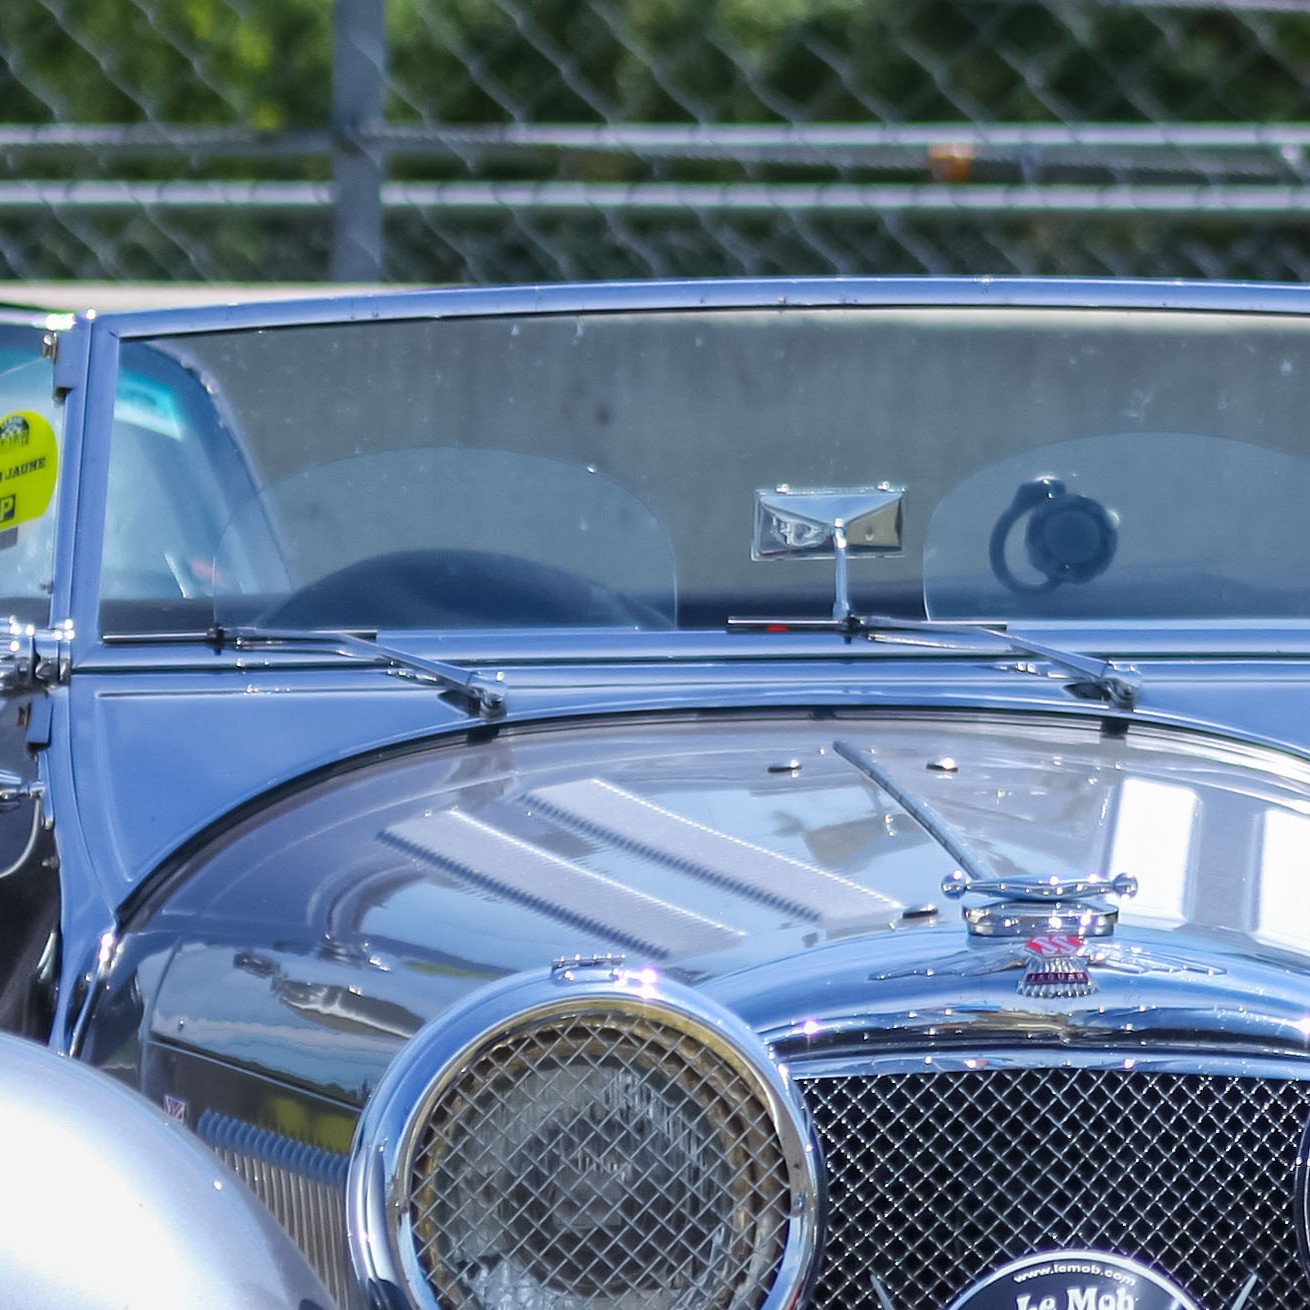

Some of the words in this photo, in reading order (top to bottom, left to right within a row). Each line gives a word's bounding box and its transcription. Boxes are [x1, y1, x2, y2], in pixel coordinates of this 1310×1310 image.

[5, 457, 46, 480] JAUNE
[1030, 973, 1084, 983] JAGUAR
[1013, 1263, 1137, 1287] www.lemob.com
